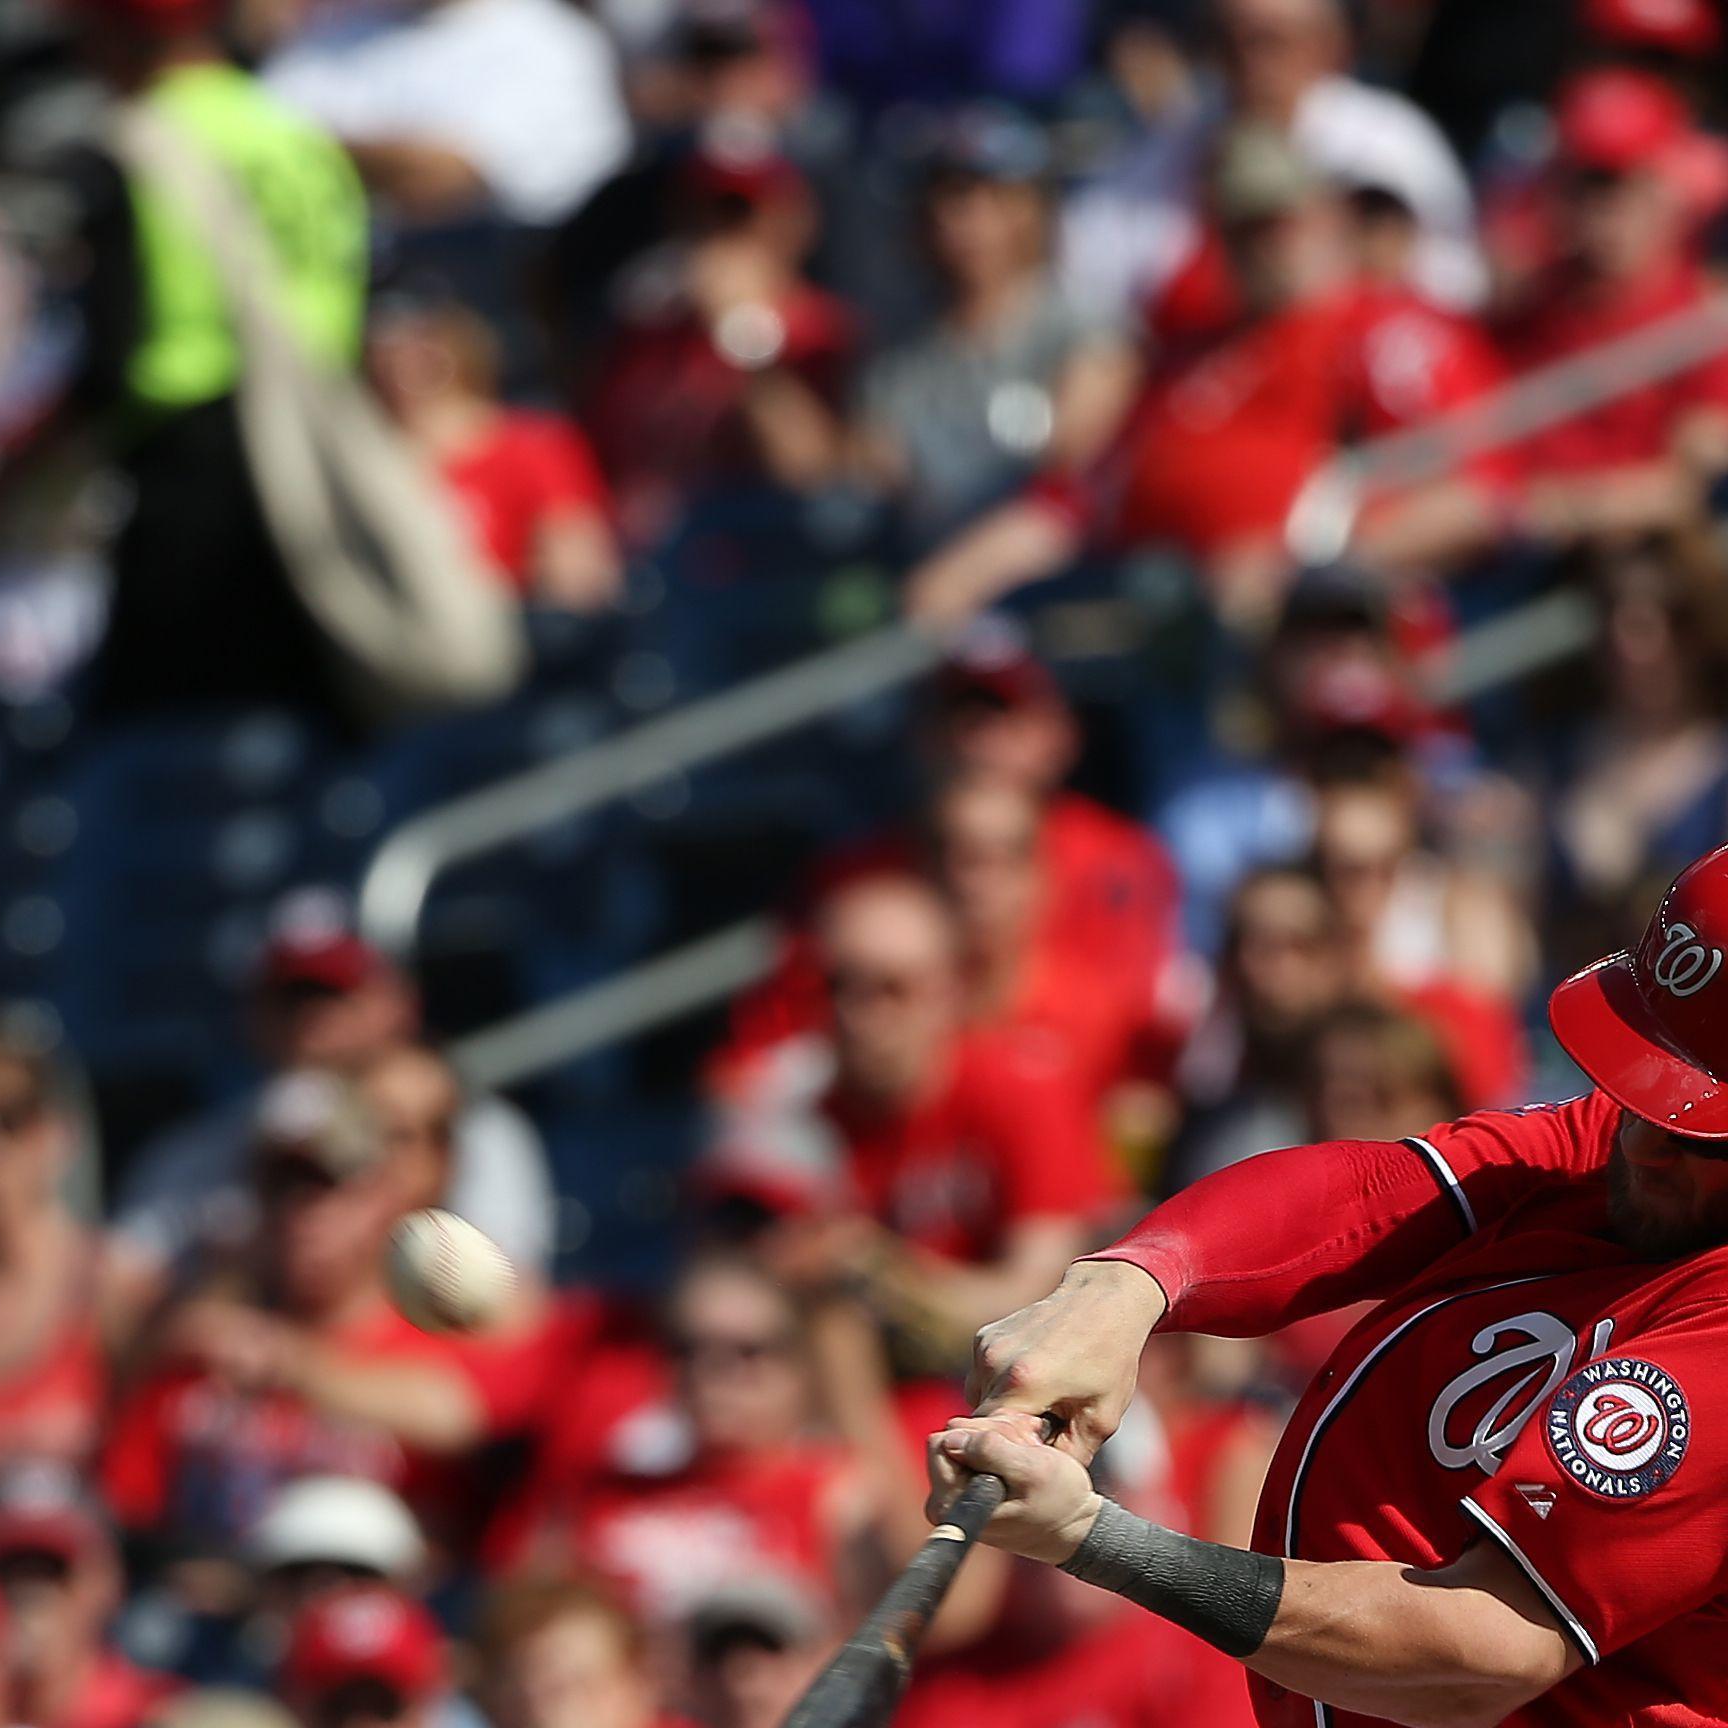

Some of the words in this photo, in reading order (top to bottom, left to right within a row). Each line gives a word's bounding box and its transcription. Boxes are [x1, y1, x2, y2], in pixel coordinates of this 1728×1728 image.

[1550, 1409, 1642, 1495] NATIONALS
[1582, 1360, 1687, 1461] WASHINGTON
[1583, 1394, 1660, 1456] W
